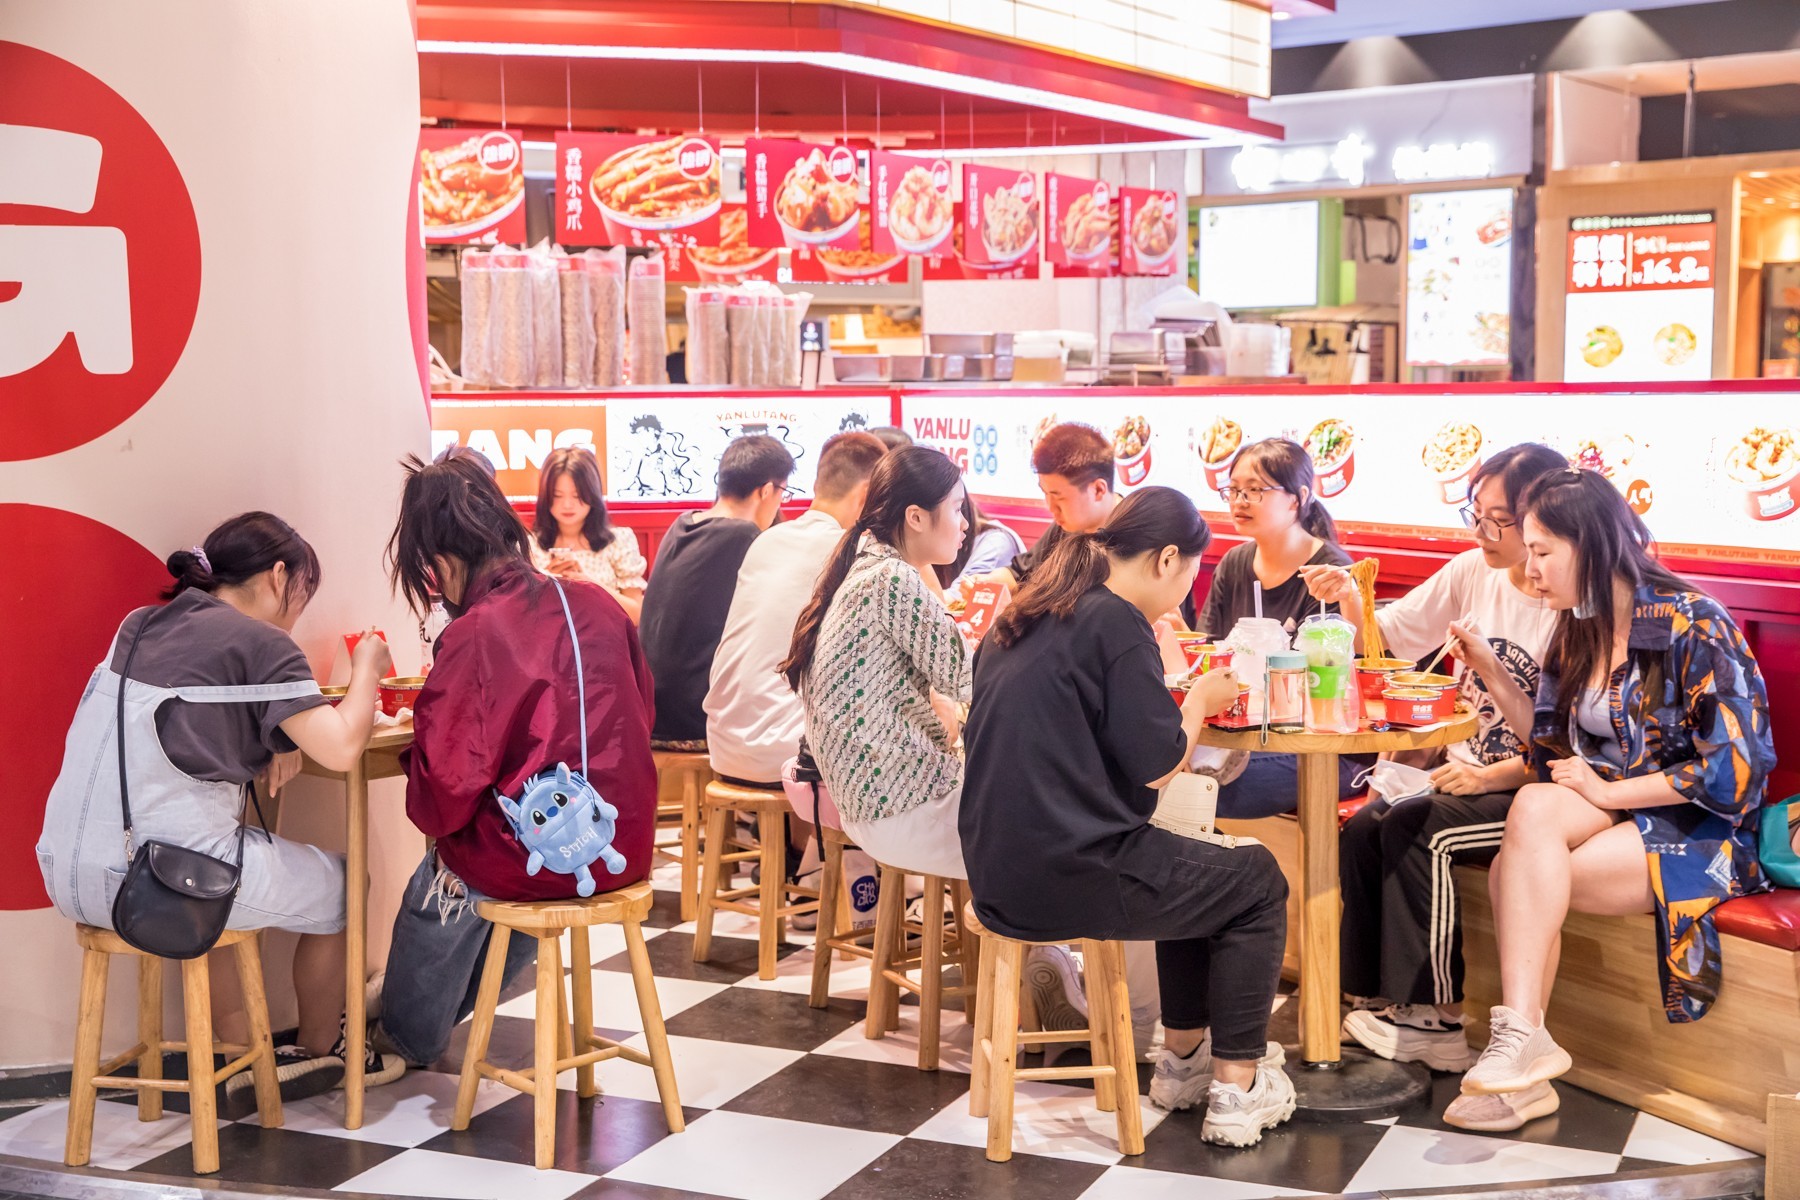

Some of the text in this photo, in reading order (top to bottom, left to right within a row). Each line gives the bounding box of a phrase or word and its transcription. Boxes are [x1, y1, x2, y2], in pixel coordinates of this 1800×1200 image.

[716, 410, 797, 422] YANLUTANG
[914, 417, 971, 440] YANLU
[1706, 548, 1760, 559] YANLUTANG
[970, 608, 985, 627] 4
